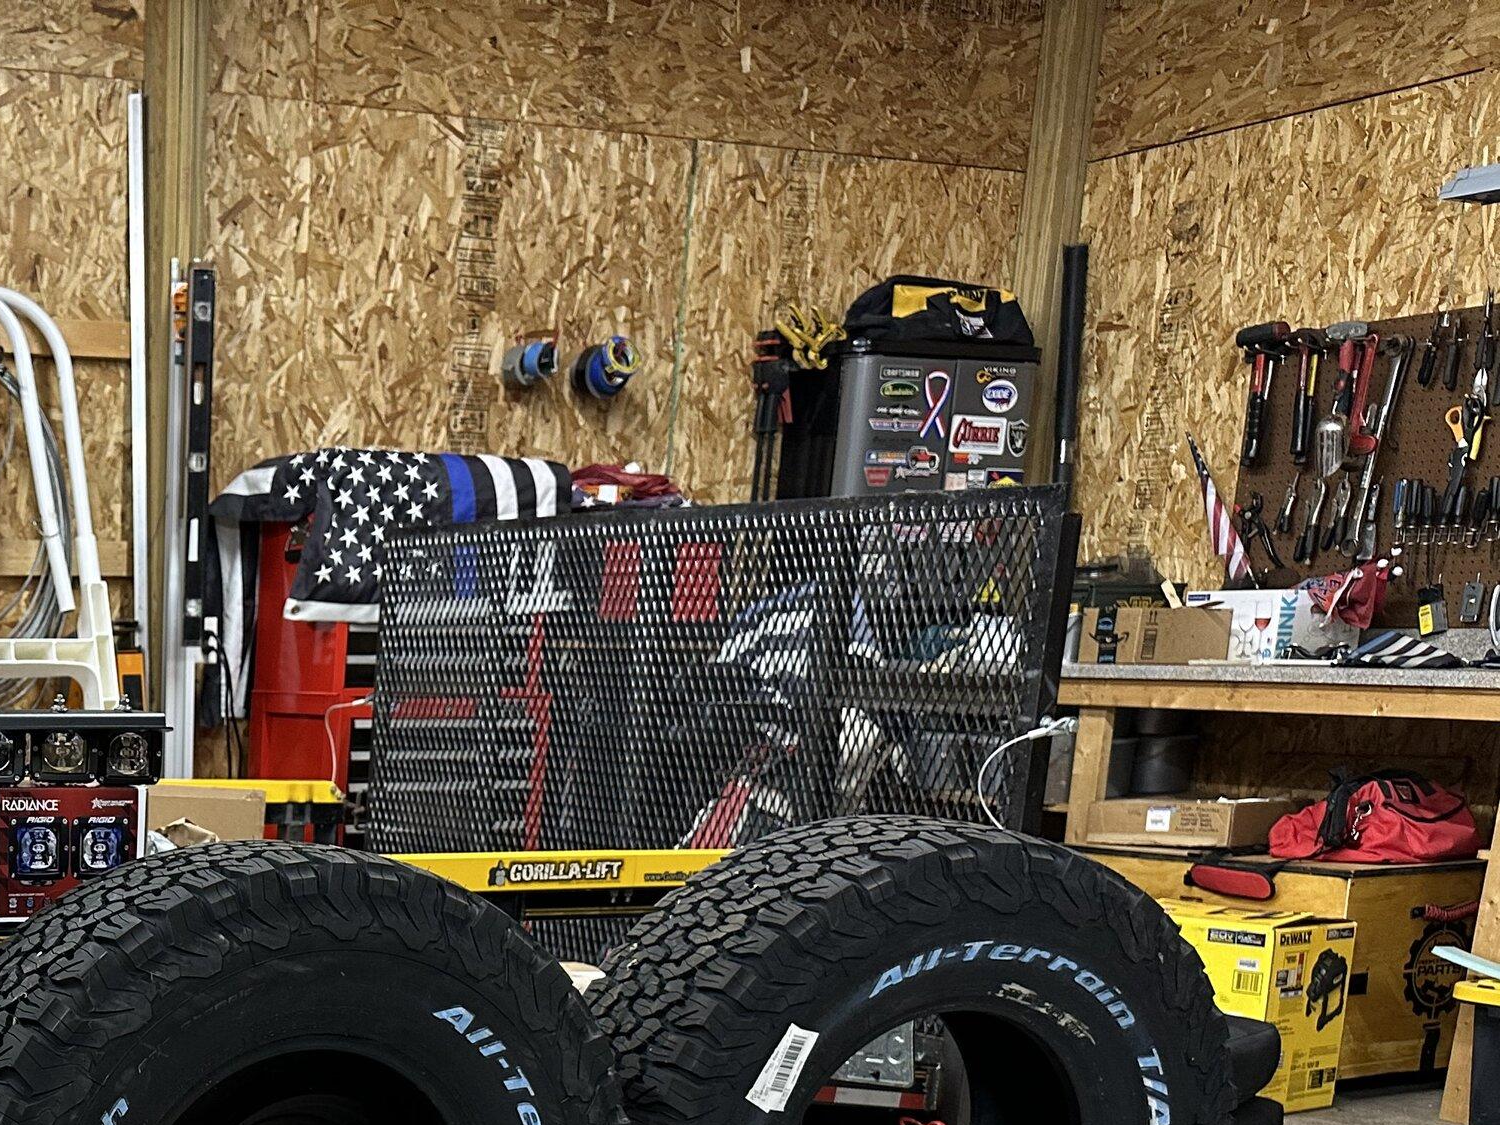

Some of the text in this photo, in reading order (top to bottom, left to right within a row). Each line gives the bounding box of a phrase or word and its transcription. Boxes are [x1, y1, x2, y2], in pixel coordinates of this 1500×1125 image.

[2, 800, 58, 811] RADIANCE
[509, 861, 622, 882] GORILLA-LIFT
[869, 940, 1136, 1029] All-Terrain
